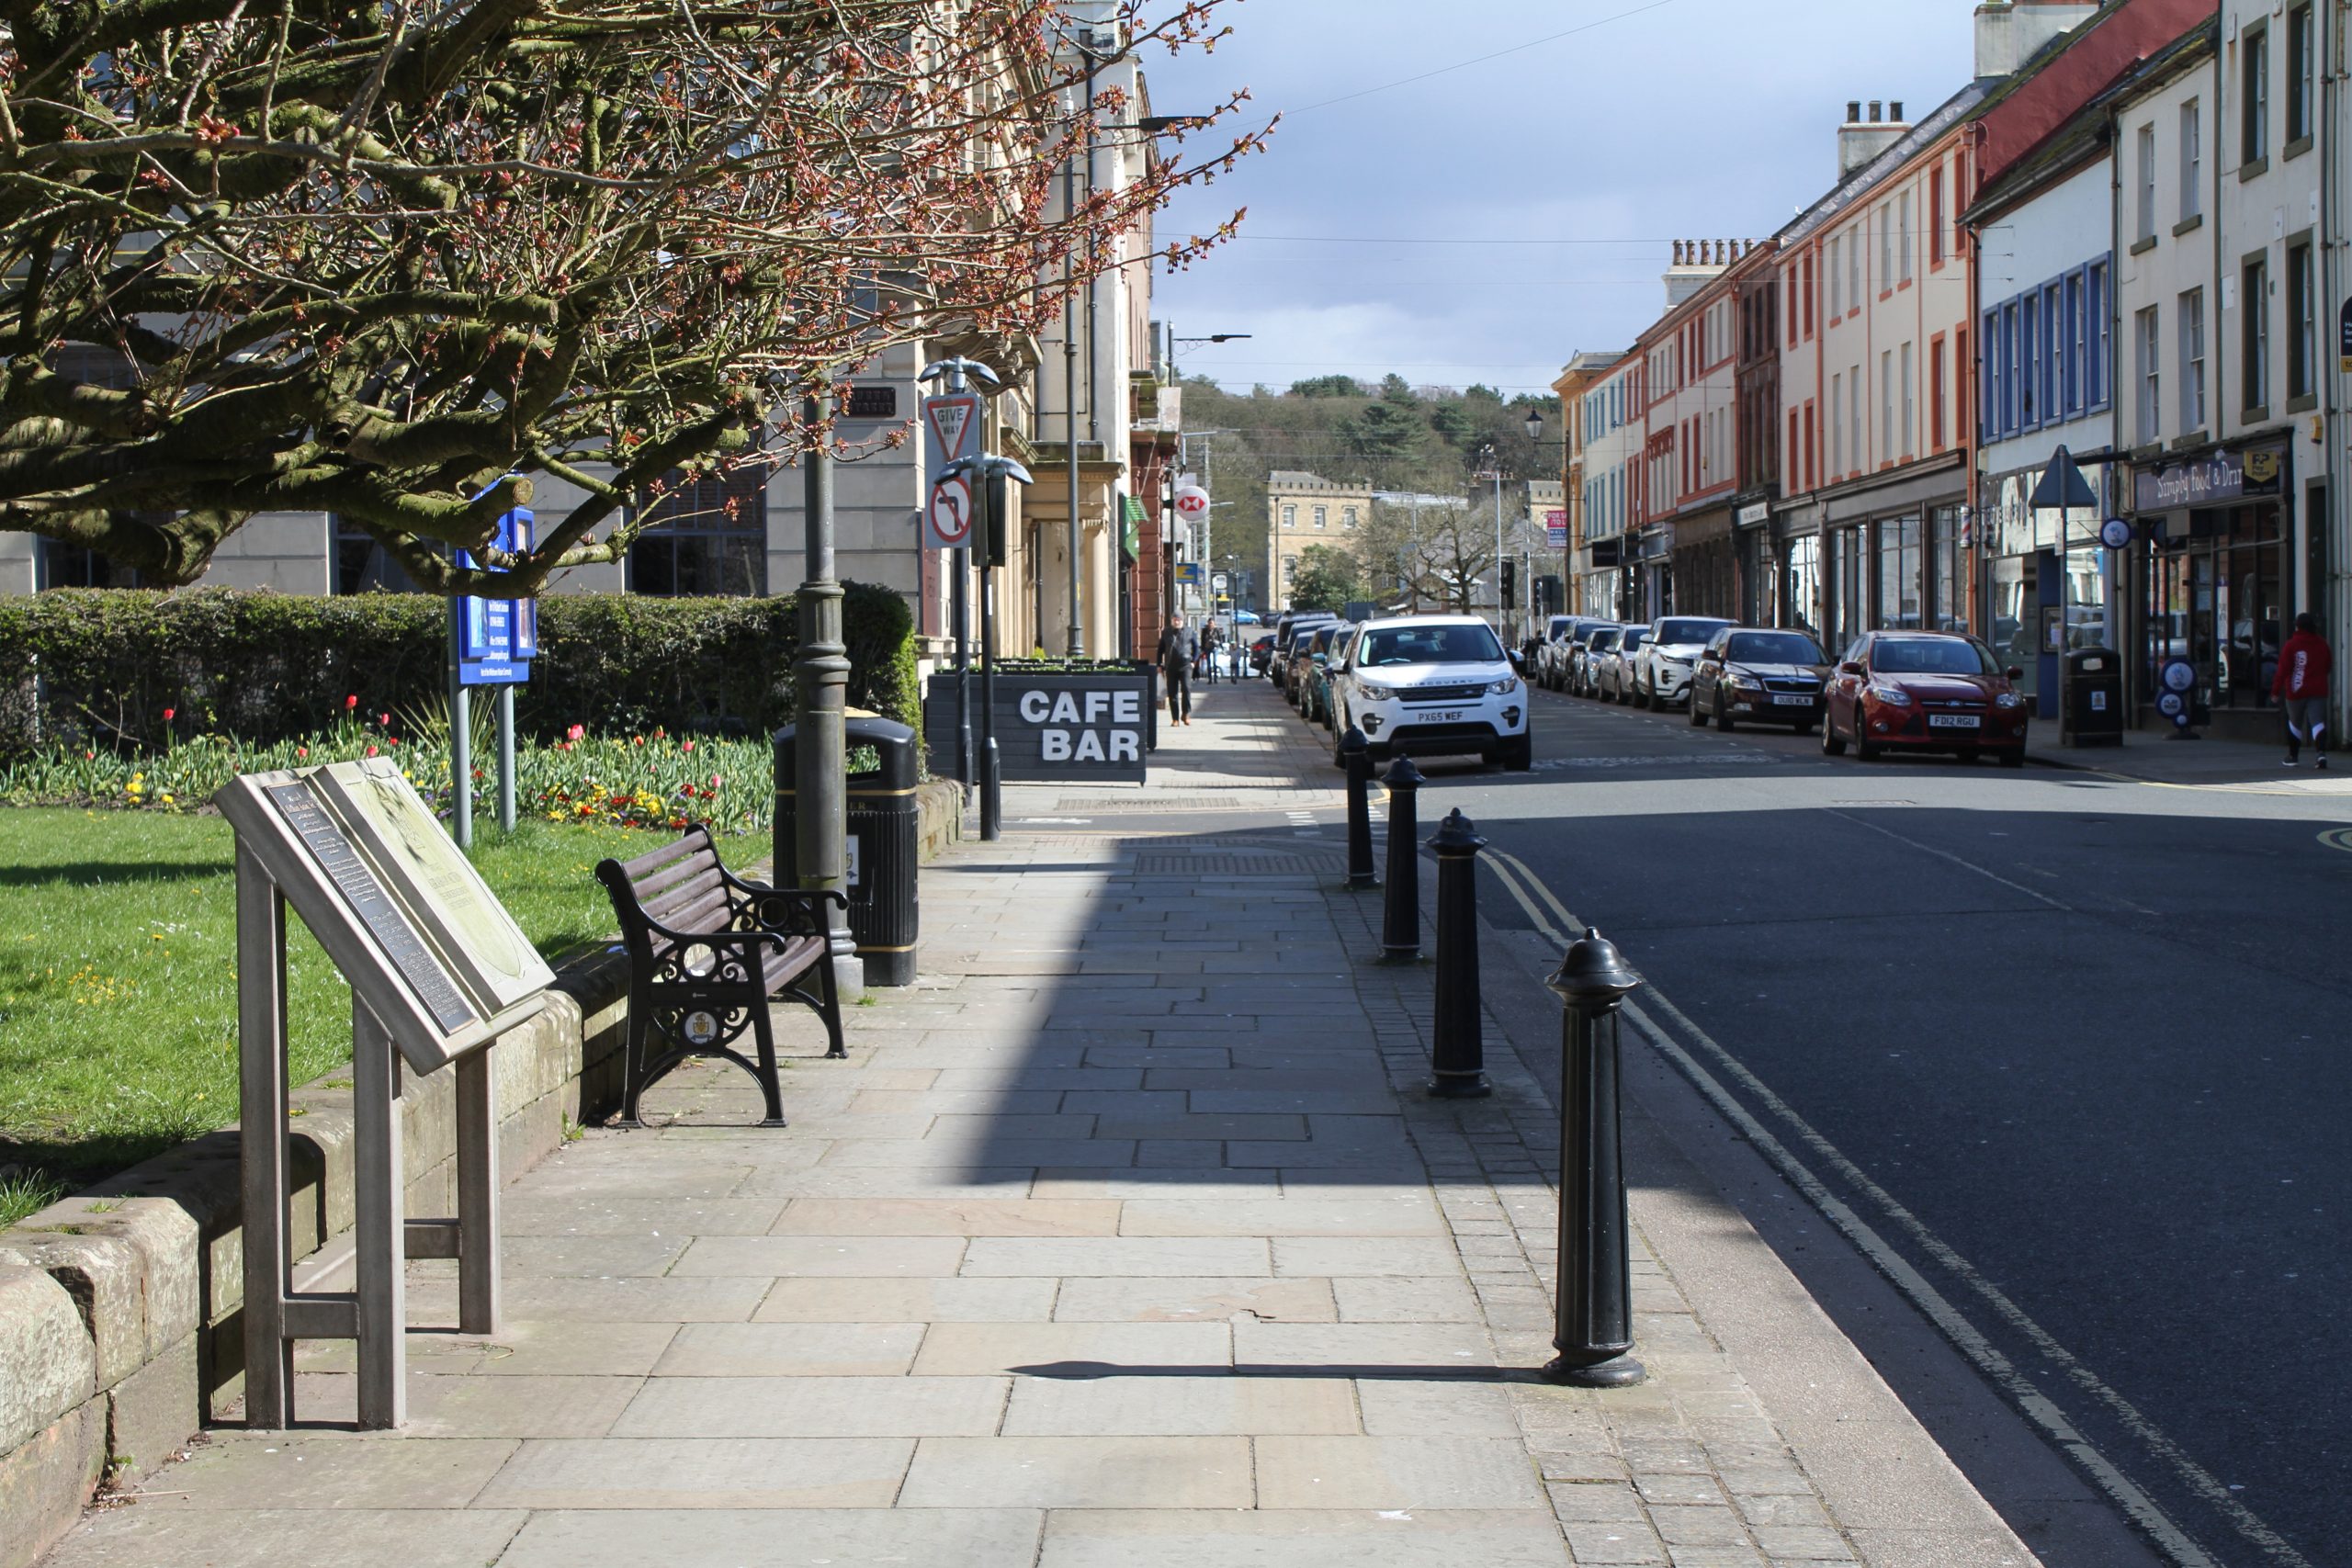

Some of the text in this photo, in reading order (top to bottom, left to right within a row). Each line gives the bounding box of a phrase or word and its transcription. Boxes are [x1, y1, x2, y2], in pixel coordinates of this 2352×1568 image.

[937, 408, 964, 422] GIVE
[943, 425, 959, 435] WAY
[2158, 469, 2188, 502] Simply
[2191, 463, 2211, 491] Food
[2213, 468, 2221, 486] &
[1020, 690, 1140, 723] CAFE
[1419, 711, 1463, 723] PX65 WEF
[1934, 716, 1955, 726] FD12
[1042, 729, 1139, 761] BAR
